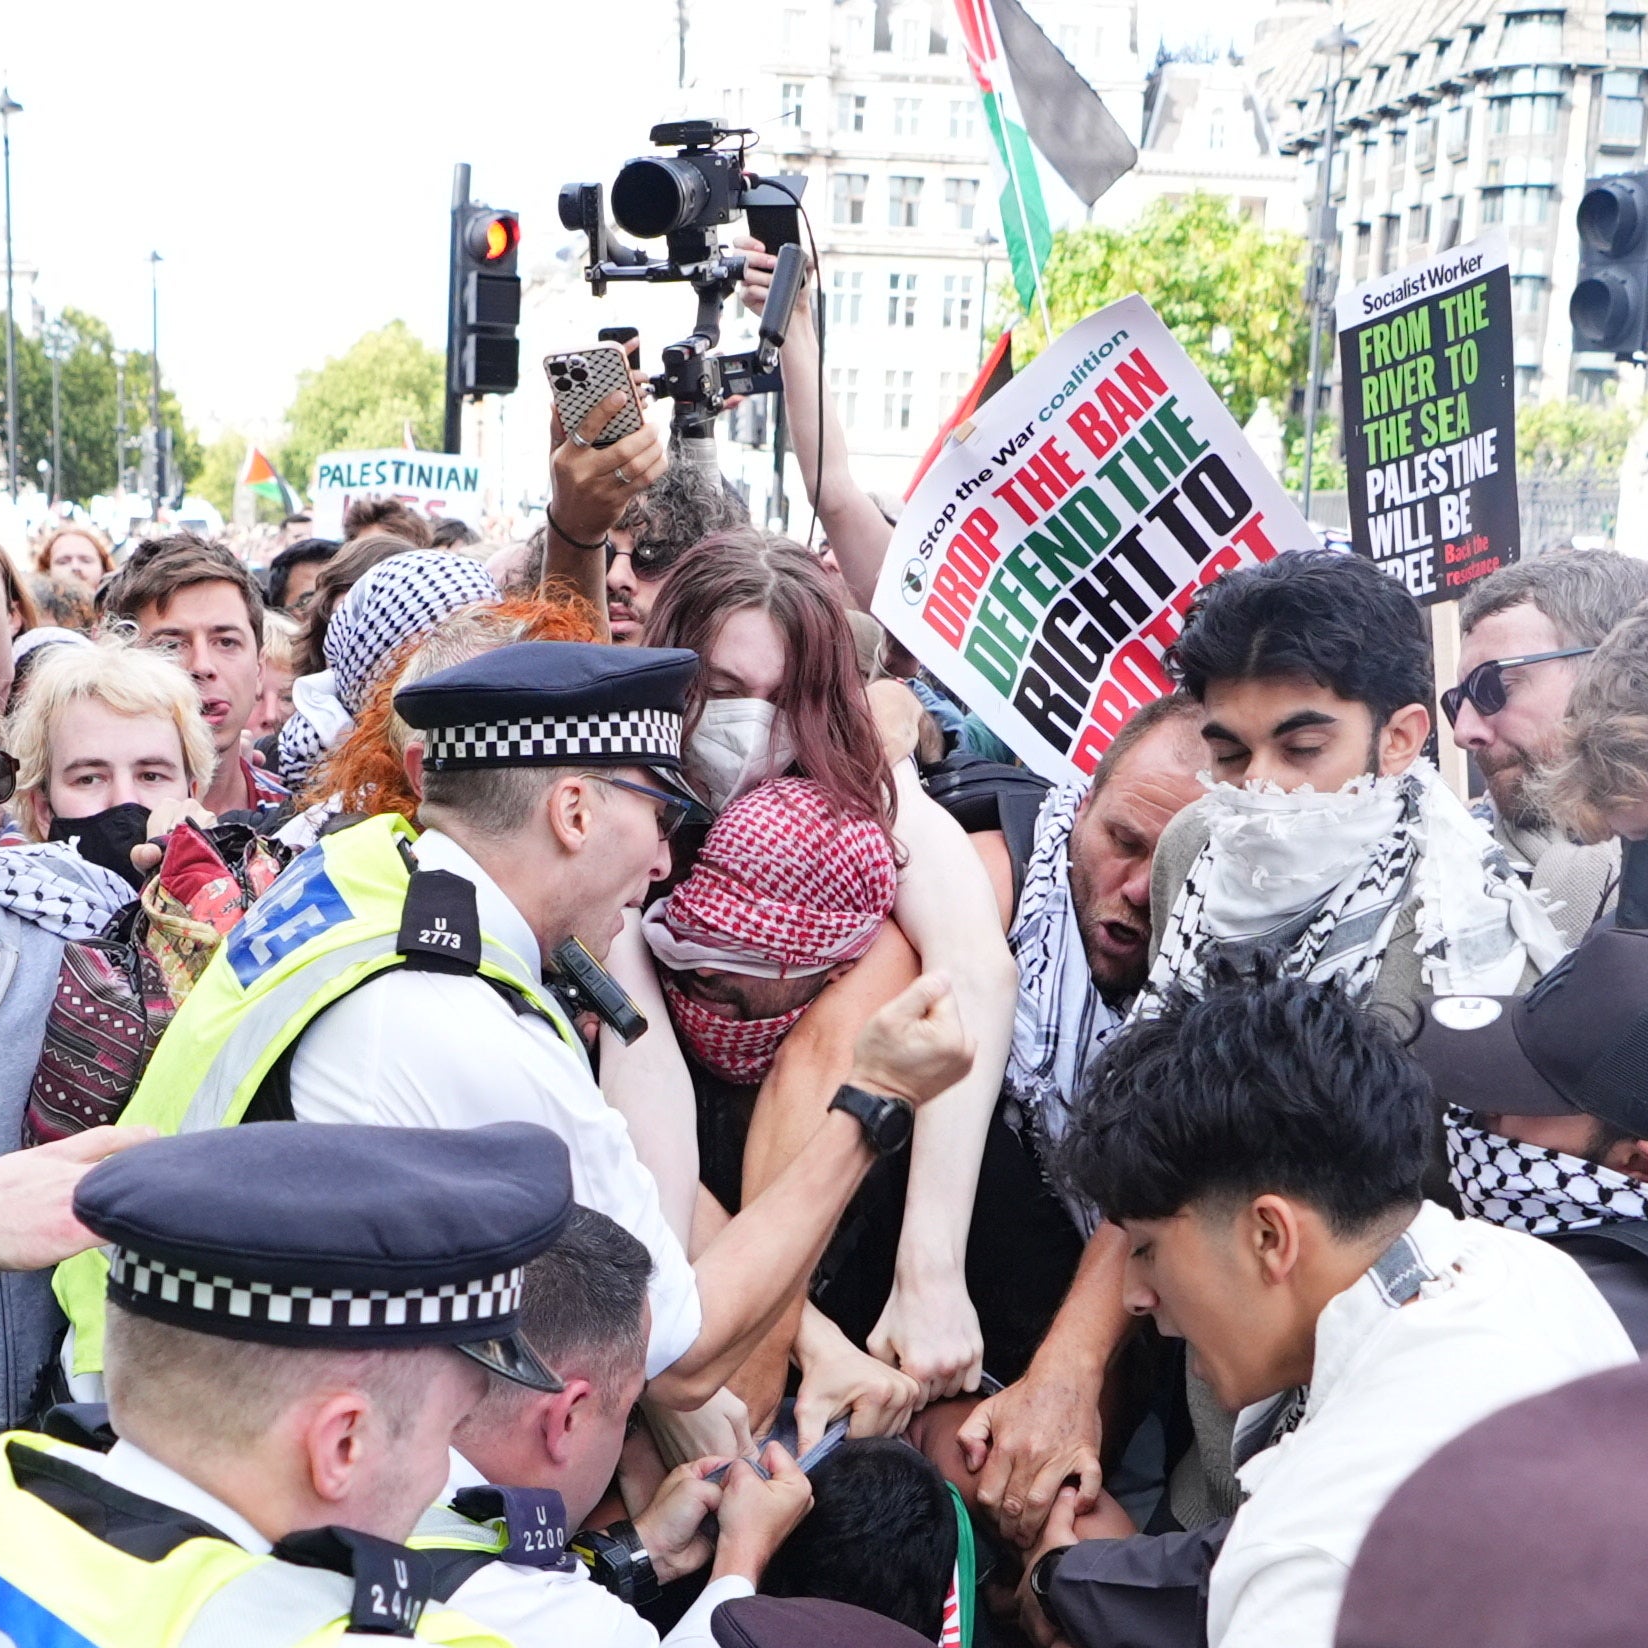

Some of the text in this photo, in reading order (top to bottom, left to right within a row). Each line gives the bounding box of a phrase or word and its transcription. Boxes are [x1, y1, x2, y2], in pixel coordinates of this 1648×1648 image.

[1362, 252, 1484, 315] Socialist Worker
[1358, 282, 1490, 374] FROM THE
[1361, 338, 1479, 421] RIVER TO
[919, 327, 1131, 561] Stop the War coalition
[1362, 391, 1471, 466] THE SEA
[318, 460, 479, 493] PALESTINIAN
[922, 346, 1170, 651] DROP THE BAN
[1366, 427, 1499, 514] PALESTINE
[963, 395, 1211, 699] DEFEND THE
[1368, 489, 1472, 560] WILL BE
[1444, 533, 1490, 565] Back the
[1012, 453, 1253, 756] RIGHT TO
[1446, 555, 1501, 587] resistance
[1070, 511, 1279, 777] PROTT
[418, 930, 461, 949] 2773
[435, 917, 447, 931] U
[523, 1527, 565, 1552] 2200
[536, 1506, 547, 1525] U
[393, 1558, 409, 1590] U
